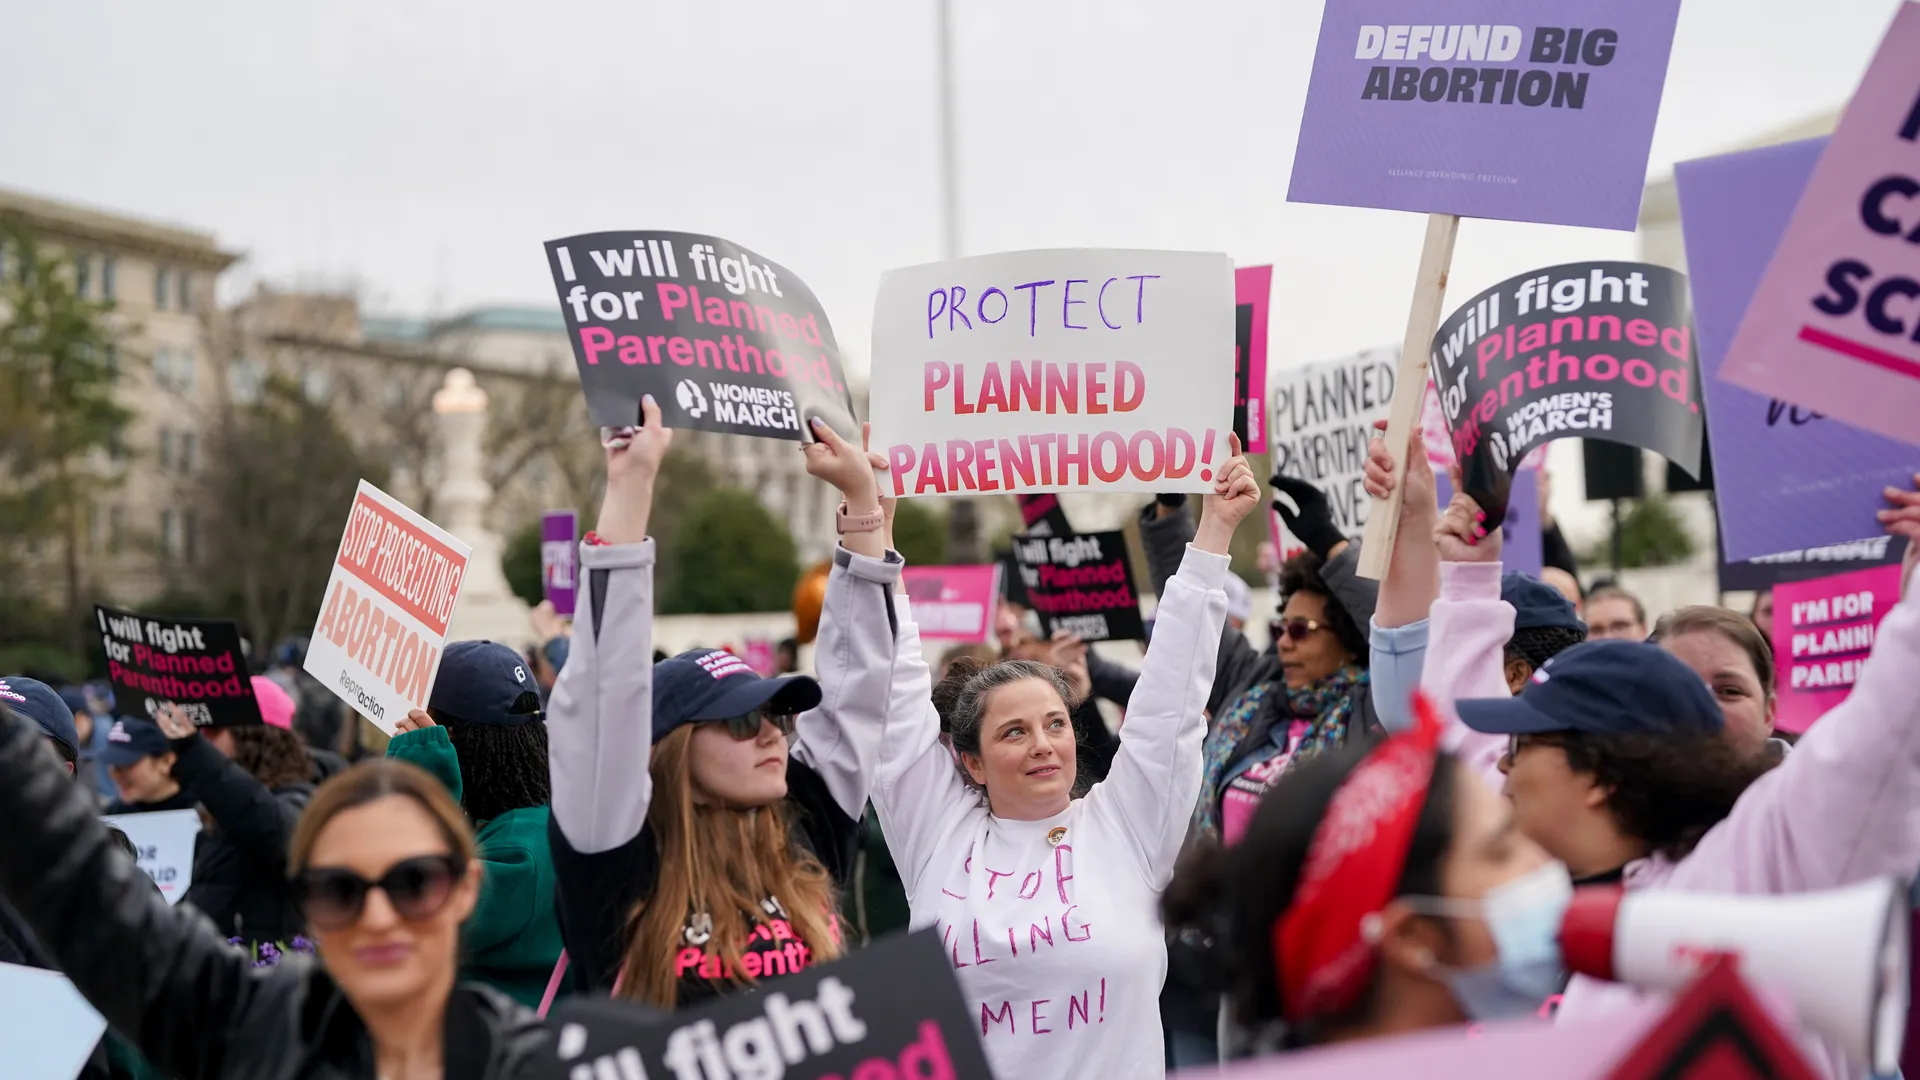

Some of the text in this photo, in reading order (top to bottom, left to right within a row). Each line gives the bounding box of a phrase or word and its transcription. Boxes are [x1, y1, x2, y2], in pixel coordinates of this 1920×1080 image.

[1355, 25, 1618, 66] DEFUND BIG
[1361, 66, 1590, 109] ABORTION
[1387, 168, 1518, 185] ALLIANCE DEFENDING FREEDOM
[556, 240, 783, 297] I will fight
[566, 283, 823, 347] for Planned
[928, 275, 1160, 339] PROTECT
[1442, 293, 1500, 368] will
[1514, 269, 1649, 316] fight
[580, 326, 844, 392] Parenthood.
[1476, 314, 1691, 380] Planned
[709, 382, 794, 408] WOMEN'S
[924, 360, 1145, 414] PLANNED
[1274, 363, 1394, 435] PLANNED
[1506, 392, 1612, 431] WOMEN'S
[714, 401, 799, 430] MARCH
[1509, 408, 1612, 457] MARCH
[888, 428, 1217, 496] PARENTHOOD!
[343, 502, 383, 569] STOP
[372, 521, 461, 625] PROSECUTING
[1038, 557, 1125, 587] Planned
[1049, 535, 1103, 567] fight
[97, 609, 206, 654] I will fight
[1792, 591, 1874, 625] I'M FOR
[104, 634, 235, 674] for Planned
[318, 580, 437, 708] ABORTION
[108, 660, 250, 698] Parenthood.
[339, 669, 385, 720] Reproaction
[664, 976, 867, 1080] fight
[981, 977, 1106, 1037] MEN!
